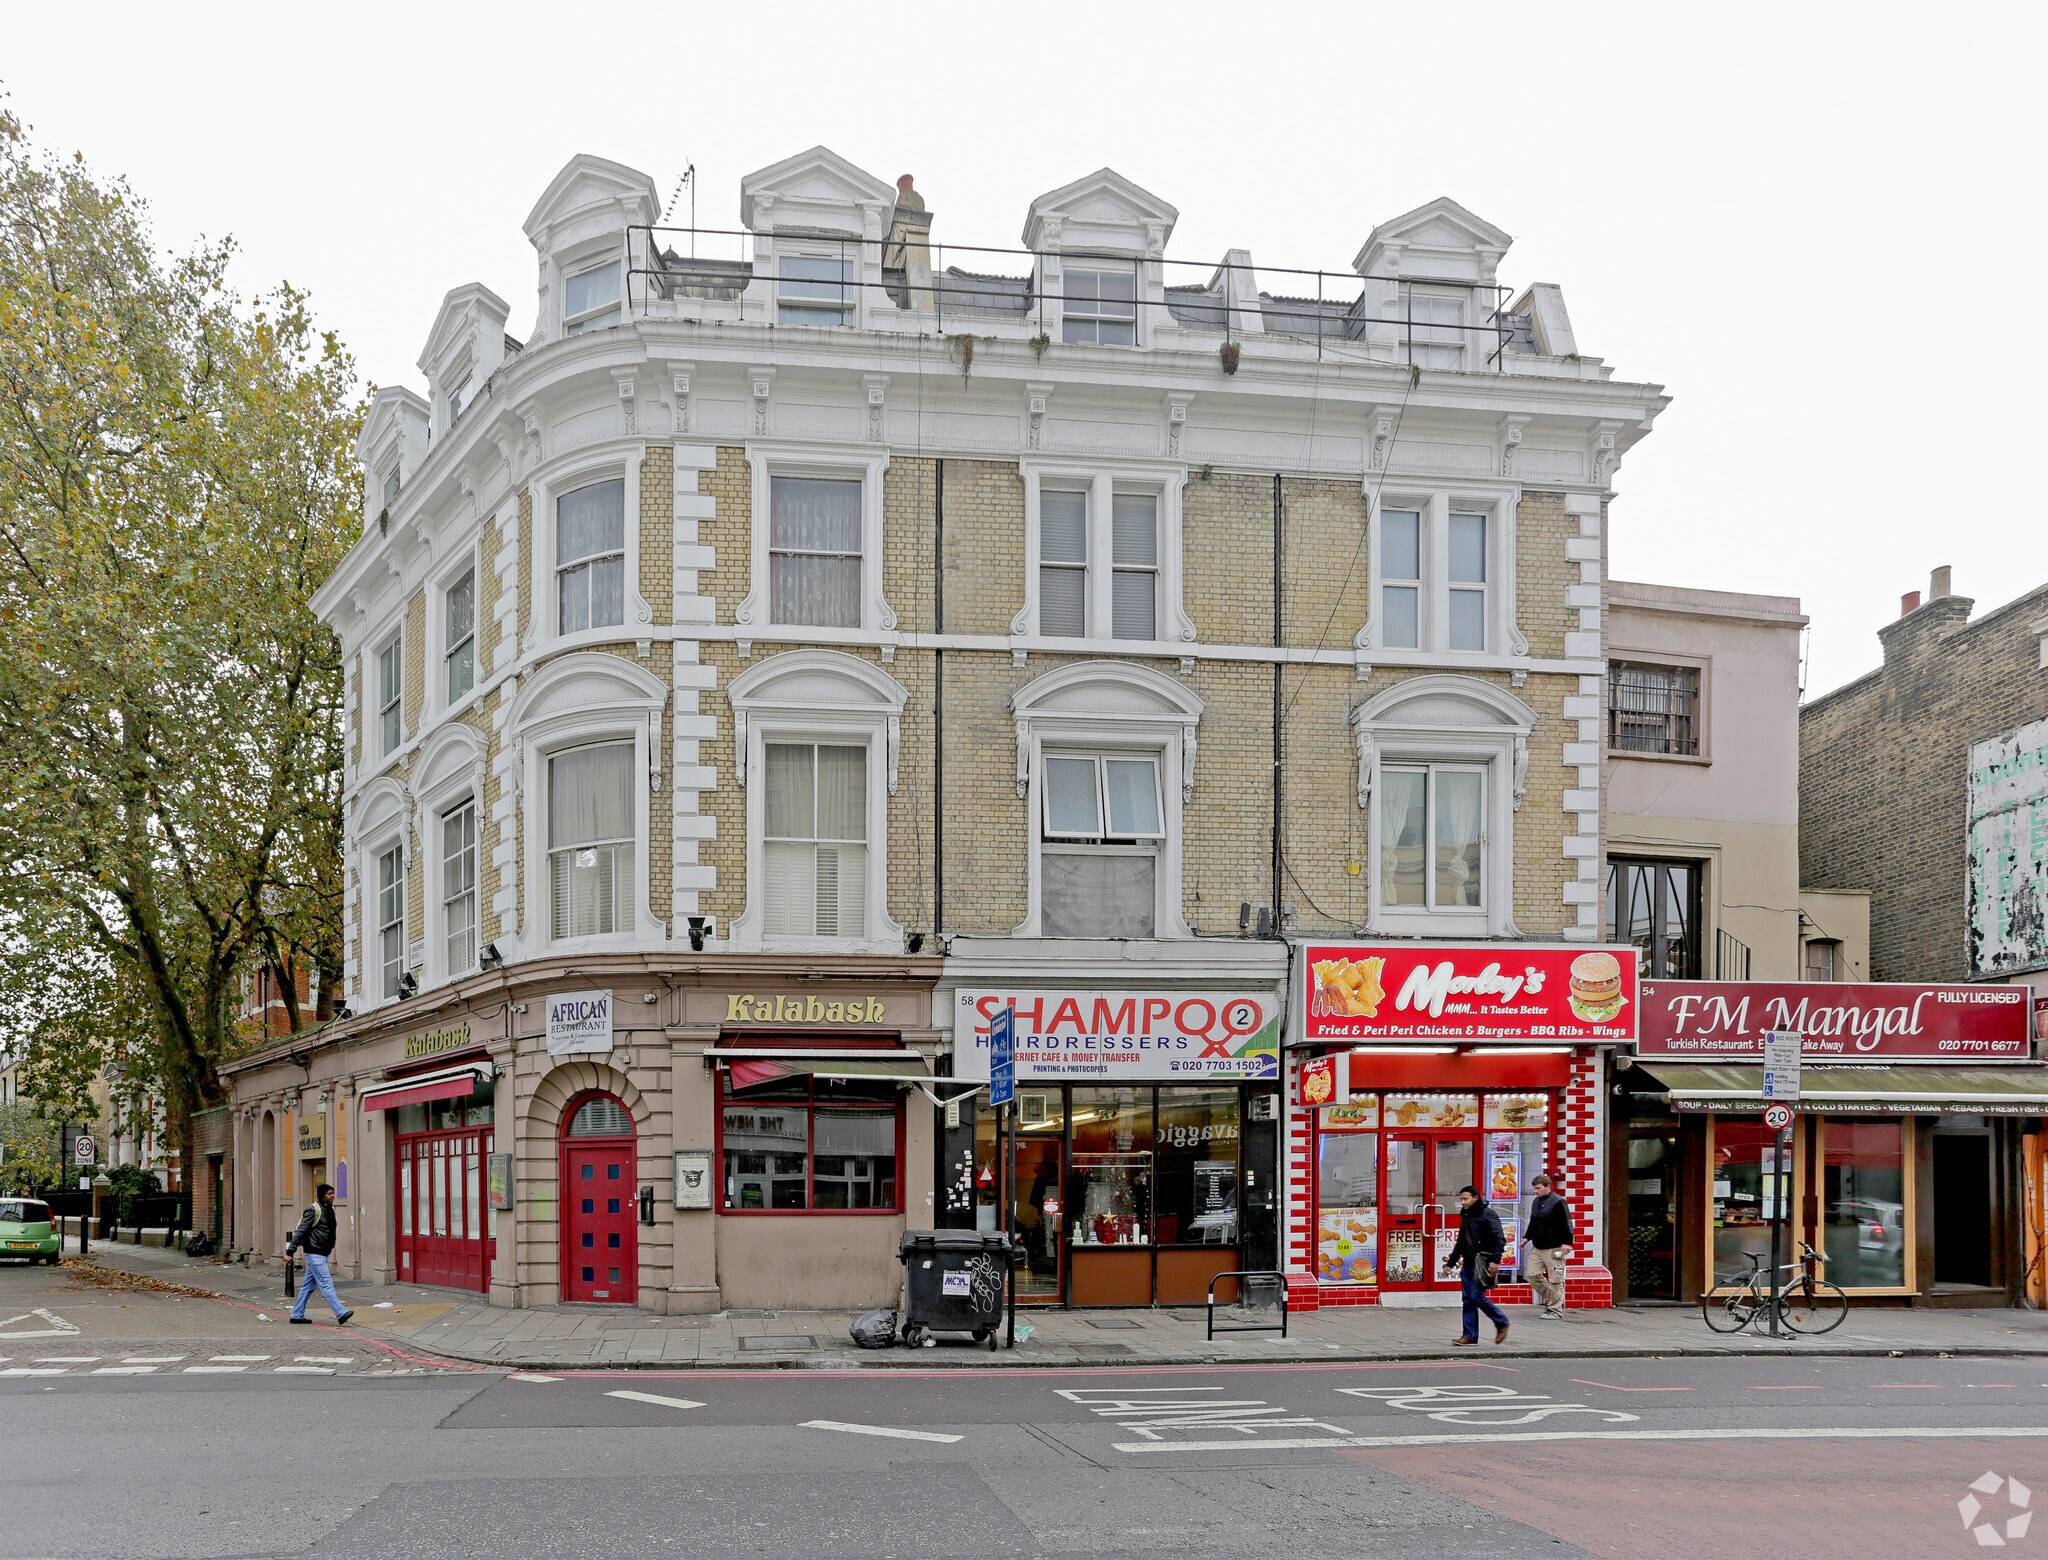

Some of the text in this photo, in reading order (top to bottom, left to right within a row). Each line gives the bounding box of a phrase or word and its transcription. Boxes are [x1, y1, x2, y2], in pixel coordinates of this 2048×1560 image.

[1395, 961, 1546, 1018] Morley's
[1642, 987, 1655, 996] 54
[961, 996, 974, 1006] 58
[1937, 992, 2021, 1004] FULLY LICENSED
[551, 1000, 607, 1022] AFRICAN
[724, 994, 885, 1023] Kalabash
[1480, 1006, 1488, 1014] It
[1490, 1006, 1519, 1014] Tastes
[1520, 1006, 1549, 1014] Better
[974, 996, 1263, 1037] SHAMPOO
[1236, 1009, 1249, 1025] 2
[1667, 991, 1934, 1051] FM Mangal
[551, 1021, 607, 1033] RESTAURANT
[1318, 1025, 1349, 1035] Fried
[1351, 1025, 1361, 1035] &
[1363, 1025, 1388, 1035] Peri
[1390, 1025, 1414, 1035] Peri
[1416, 1025, 1463, 1035] Chicken
[1465, 1025, 1474, 1035] &
[1477, 1025, 1522, 1037] Burgers
[1530, 1025, 1556, 1036] BBQ
[1558, 1025, 1584, 1036] Ribs
[1592, 1025, 1626, 1037] Wings
[404, 1022, 470, 1058] Kalabash
[976, 1036, 1188, 1049] HIRDRESSERS
[1665, 1037, 1699, 1050] Turkish
[1700, 1038, 1754, 1050] Restaurant
[1819, 1039, 1844, 1053] Away
[1938, 1040, 2020, 1051] 020 7701 6677
[1041, 1053, 1061, 1062] CAFE
[1063, 1053, 1069, 1062] &
[1071, 1053, 1099, 1062] MONEY
[1101, 1053, 1140, 1062] TRANSFER
[1033, 1065, 1061, 1073] PRINTING
[1067, 1065, 1108, 1073] PHOTOCOPIES
[1182, 1061, 1262, 1071] 020 7703 1502
[1678, 1101, 1701, 1109] SOUP
[1837, 1103, 1882, 1111] STARTERS
[1888, 1104, 1941, 1112] VEGETARIAN
[1768, 1111, 1788, 1122] 20
[79, 1143, 91, 1151] 20
[1388, 1231, 1421, 1243] FREE
[1333, 1385, 1642, 1425] BUS
[1052, 1387, 1354, 1440] LANE
